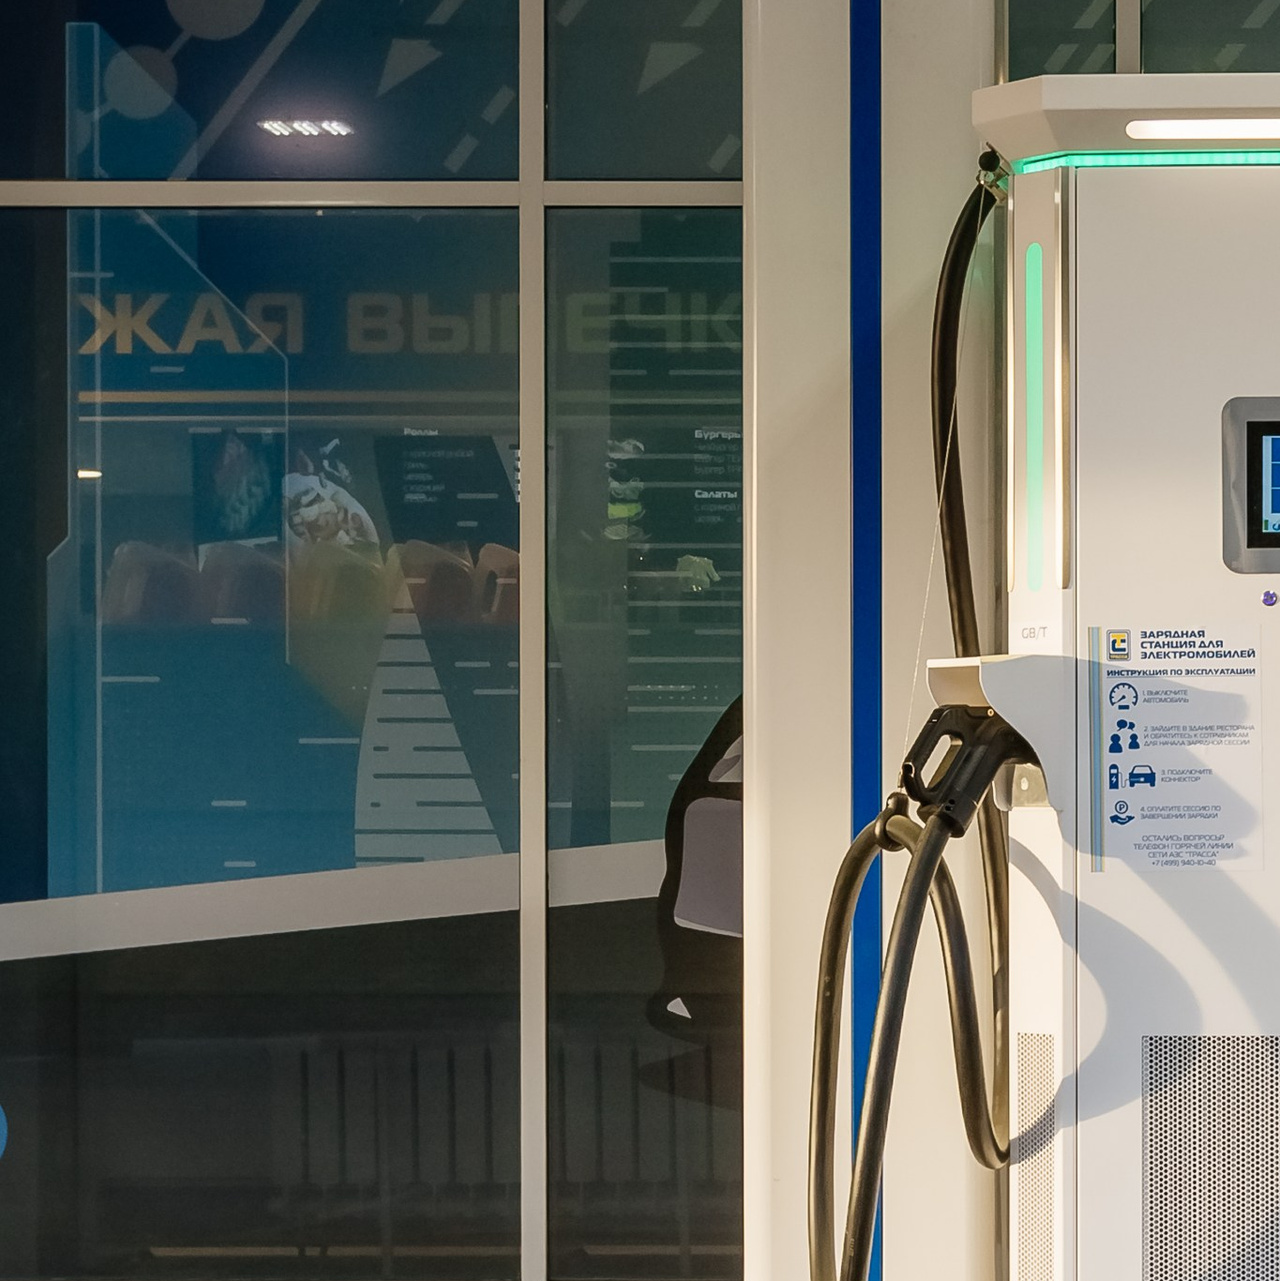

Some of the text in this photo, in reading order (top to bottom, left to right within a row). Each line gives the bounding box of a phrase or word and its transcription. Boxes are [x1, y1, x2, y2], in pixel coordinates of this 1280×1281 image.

[694, 489, 738, 499] Салаты
[1021, 626, 1048, 641] GB/T
[1141, 630, 1205, 638] ЗАРЯДНАЯ
[1141, 640, 1223, 649] СТАНЦИЯ ДЛЯ
[1141, 649, 1255, 659] ЭЛЕКТРОМОБИЛЕЙ
[1161, 859, 1179, 867] (499)
